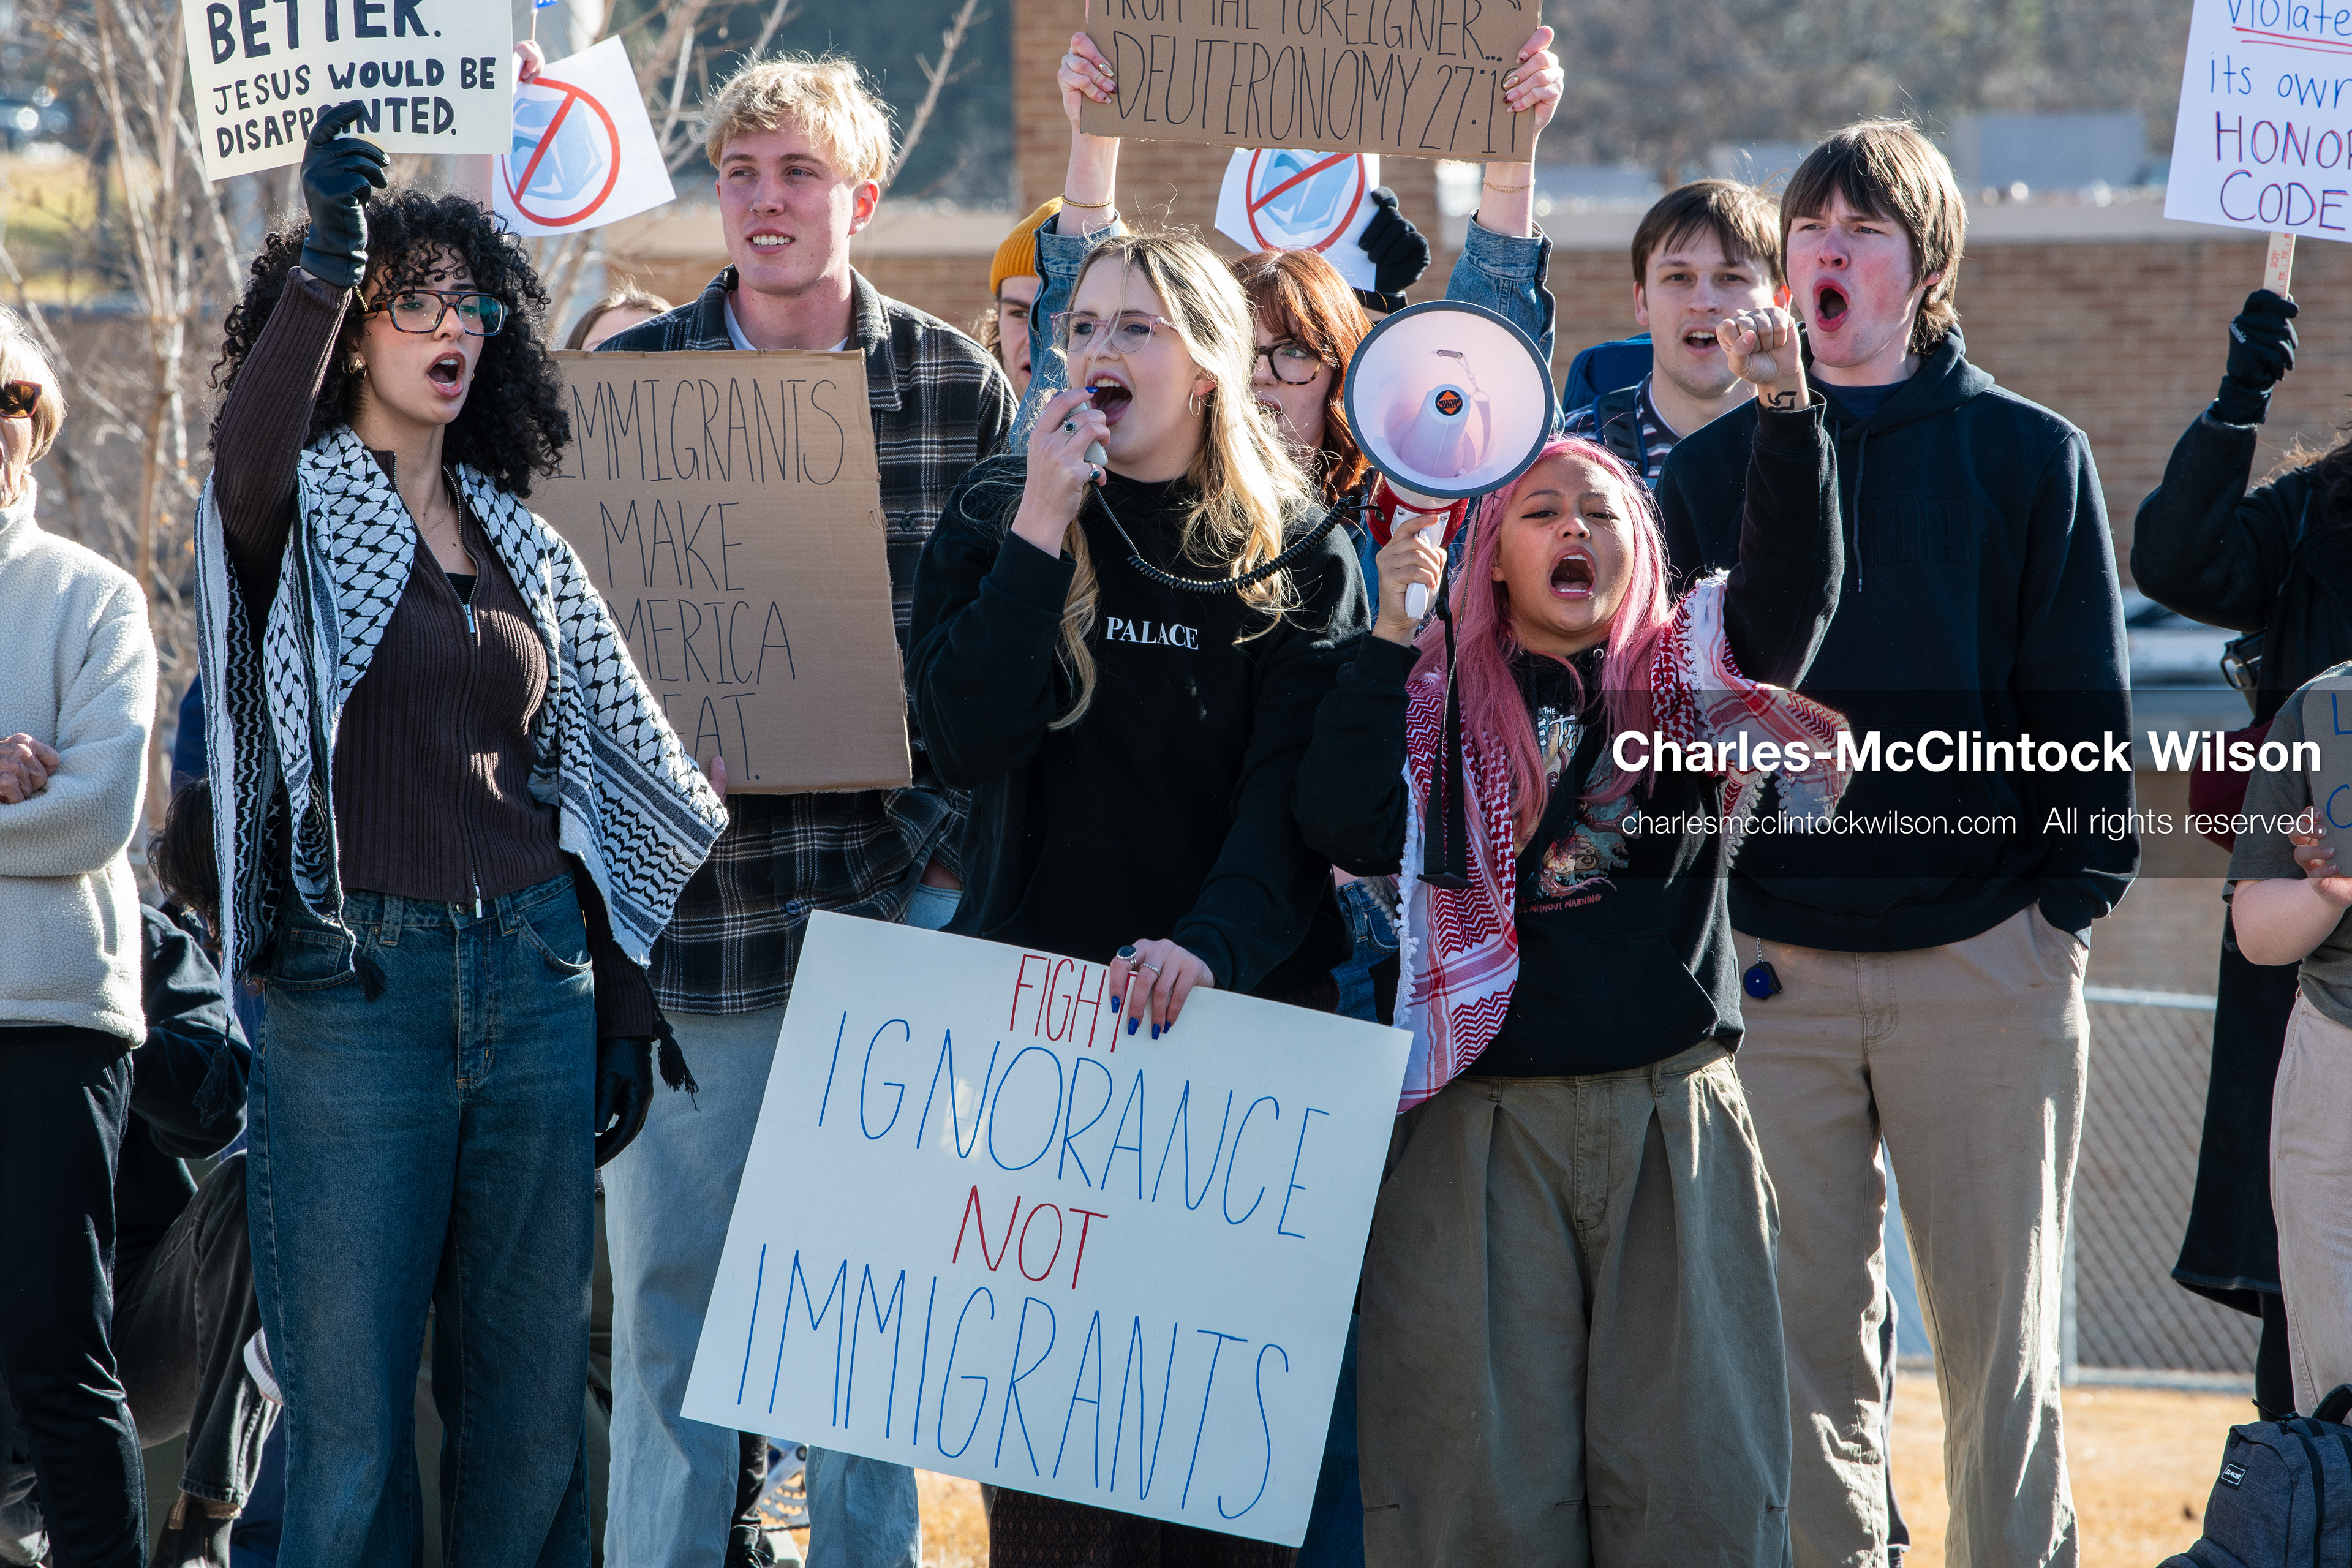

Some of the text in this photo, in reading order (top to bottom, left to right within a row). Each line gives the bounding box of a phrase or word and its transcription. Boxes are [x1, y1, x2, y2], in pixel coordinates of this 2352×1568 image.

[206, 0, 442, 64] BETTER.
[213, 56, 496, 115] JESUS WOULD BE
[1113, 31, 1422, 147] DEUTERONOMY
[2210, 51, 2252, 95] its
[216, 96, 457, 159] DISAPPNTED.
[2215, 111, 2352, 170] HONO
[2220, 169, 2349, 231] CODE
[549, 378, 844, 486] MMIGRANTS
[599, 500, 745, 592] MAKE
[606, 599, 796, 685] MERICA
[1105, 616, 1199, 650] PALACE
[1542, 706, 1556, 715] THE
[1530, 902, 1562, 913] WITHOUT
[1564, 894, 1602, 908] WARNING
[1010, 954, 1138, 1053] FIGHT
[818, 1011, 1330, 1239] IGNORANCE
[952, 1185, 1109, 1290] NOT
[737, 1243, 1289, 1519] IMMIGRANTS
